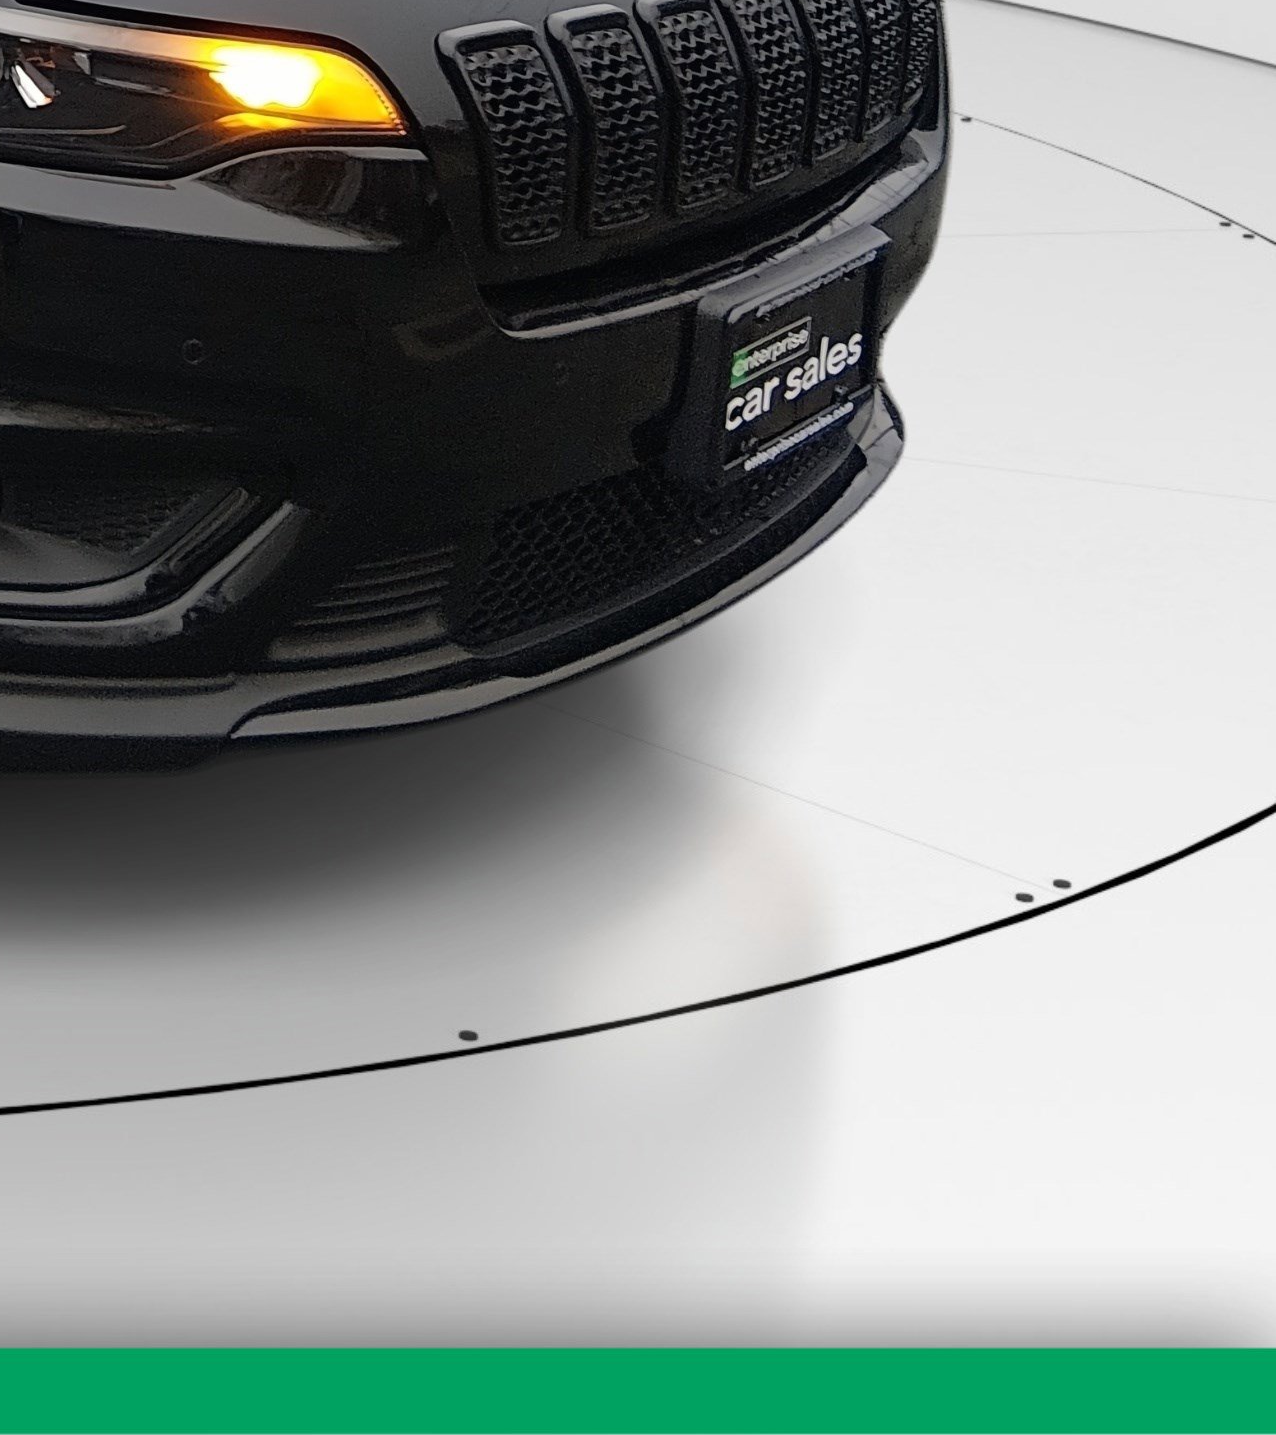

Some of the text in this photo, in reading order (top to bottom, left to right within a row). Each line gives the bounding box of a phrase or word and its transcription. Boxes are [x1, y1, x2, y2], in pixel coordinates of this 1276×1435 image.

[725, 333, 863, 431] car sales
[732, 329, 808, 377] enterprise
